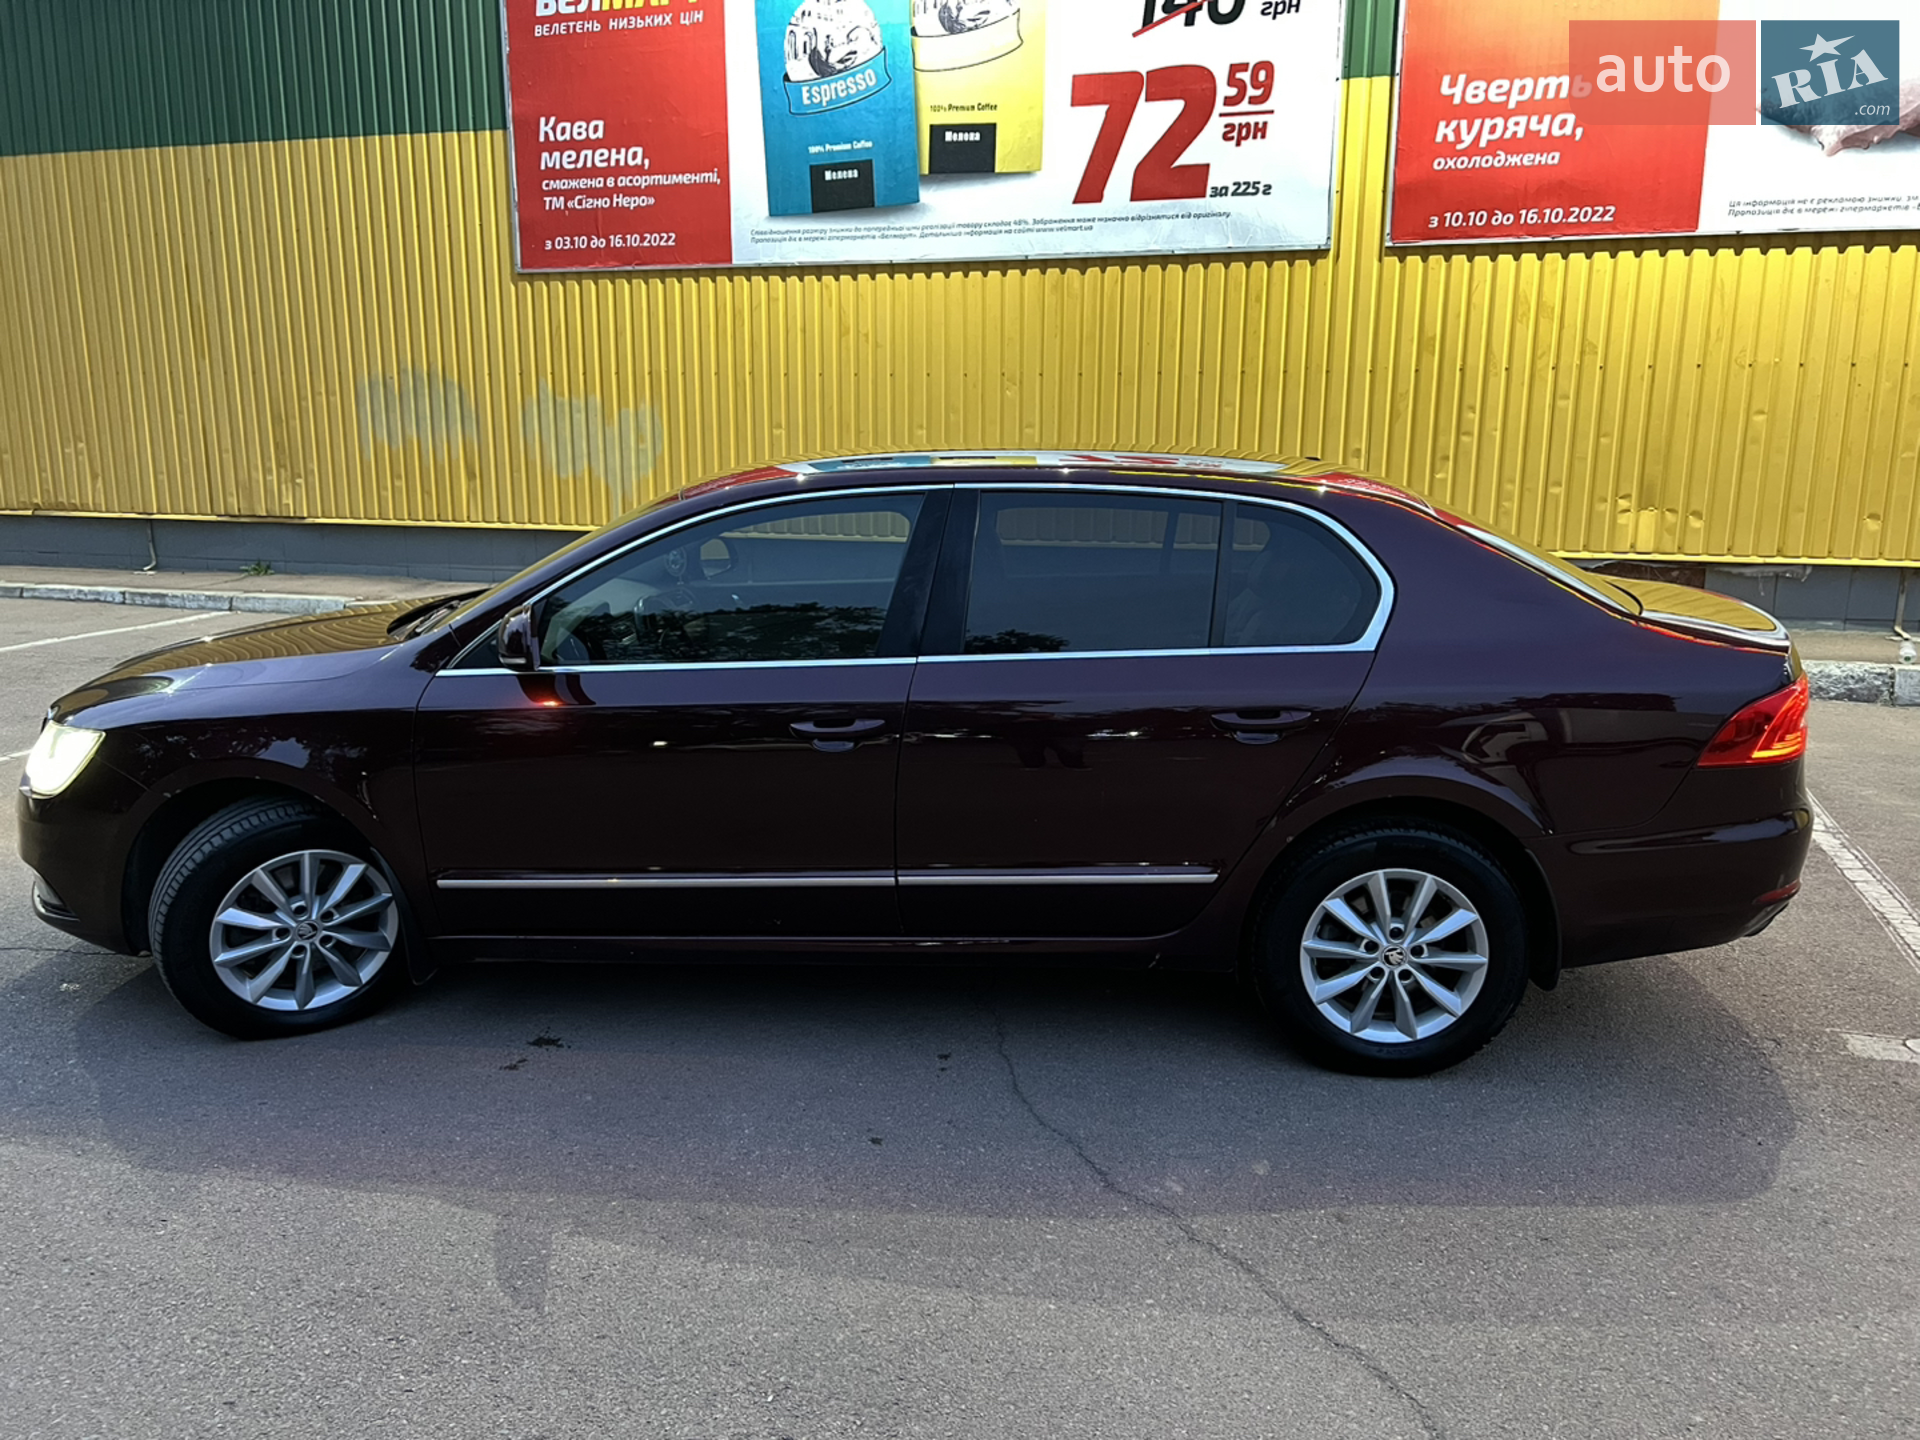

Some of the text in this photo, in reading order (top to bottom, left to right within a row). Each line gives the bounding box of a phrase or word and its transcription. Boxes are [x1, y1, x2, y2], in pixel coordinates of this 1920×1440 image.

[534, 10, 704, 37] ВЕЛЕТЕНЬ НИЗЬКИХ ЦІН
[801, 68, 877, 107] Espresso
[977, 102, 998, 111] Coffee
[538, 116, 605, 142] Кава
[1070, 60, 1275, 205] 72 59
[1221, 118, 1269, 146] грн
[1434, 109, 1585, 151] куряча,
[540, 146, 650, 170] мелена,
[1432, 149, 1561, 171] охолоджена
[542, 168, 721, 190] смажена в асортименті,
[1209, 183, 1230, 198] за
[543, 194, 655, 210] ТМ «Сігно Неро»
[1428, 205, 1616, 229] з 10.10 до 16.10.2022
[545, 232, 676, 250] з 03.10 до 16.10.2022
